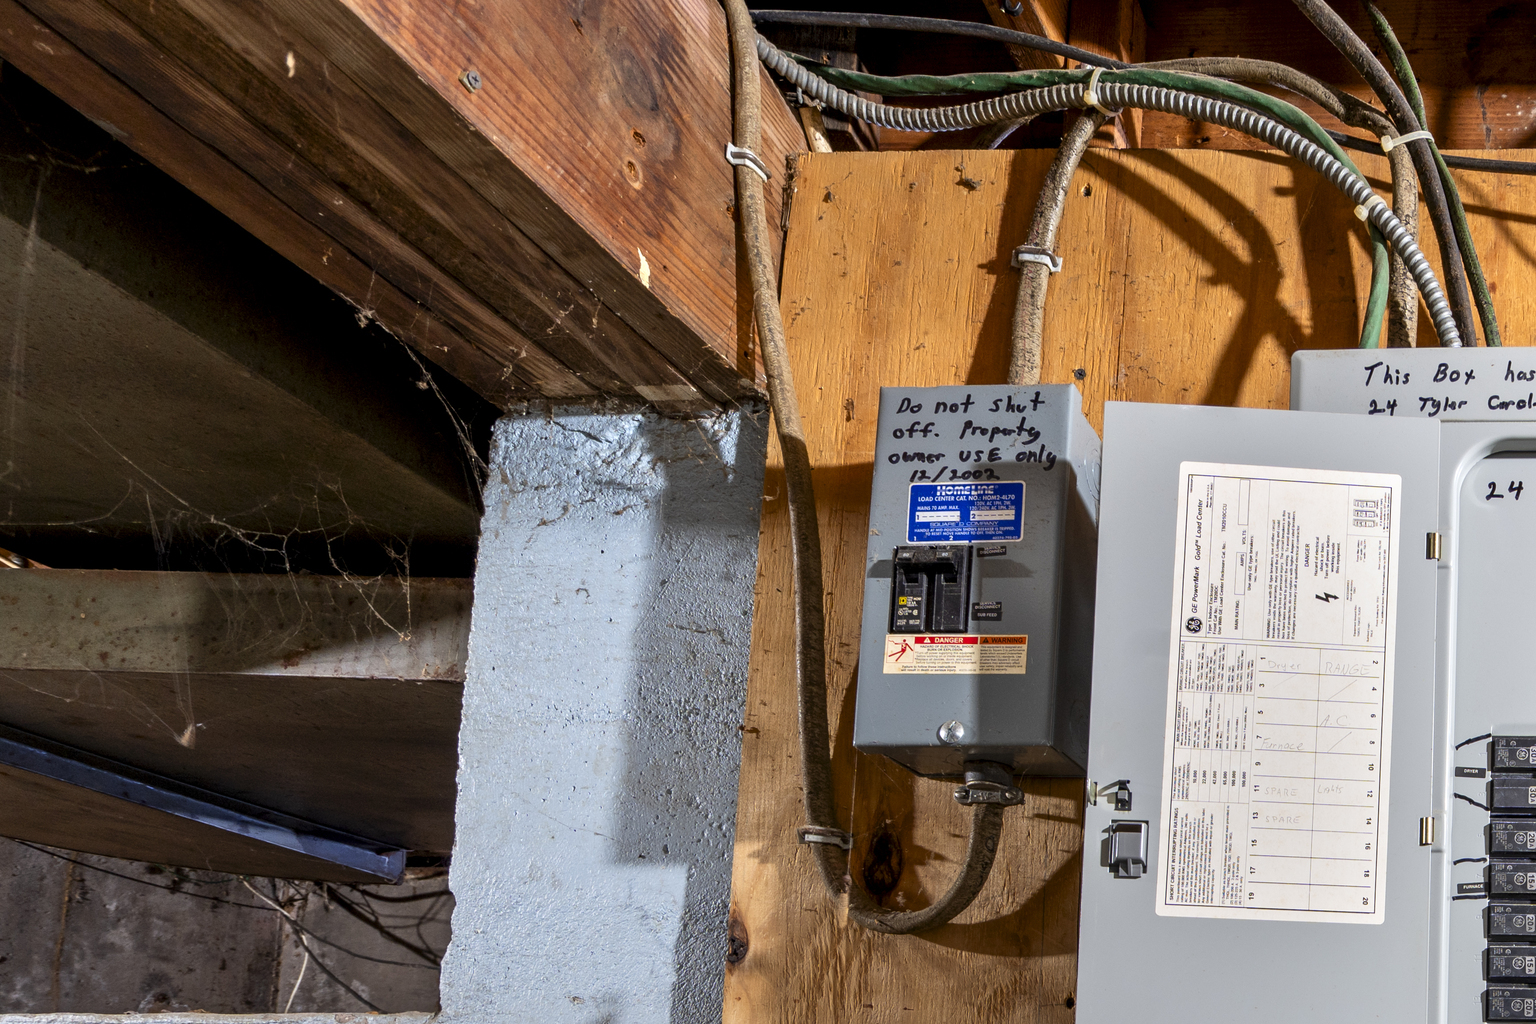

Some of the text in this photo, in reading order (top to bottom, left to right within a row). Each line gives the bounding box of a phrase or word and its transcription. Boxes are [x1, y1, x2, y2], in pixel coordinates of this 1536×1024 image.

[1365, 362, 1410, 386] This
[1433, 363, 1476, 384] Box
[1505, 361, 1536, 382] has
[896, 391, 1045, 414] Do not shut
[1368, 399, 1397, 415] 24
[1419, 396, 1468, 417] Tyler
[893, 417, 1041, 445] off. Property
[888, 452, 945, 464] owner
[1015, 444, 1057, 471] only
[910, 466, 1000, 482] 12/2002
[1486, 481, 1523, 501] 24
[1191, 603, 1197, 613] GE
[1325, 660, 1370, 676] RANGE
[1368, 763, 1374, 771] 10
[1254, 784, 1259, 792] 11
[1264, 786, 1298, 796] SPARE
[1252, 811, 1258, 819] 13
[1265, 813, 1301, 823] SPARE
[1251, 838, 1257, 846] 15
[1250, 866, 1255, 874] 17
[1363, 869, 1369, 877] 18
[1248, 891, 1254, 900] 19
[1362, 896, 1368, 905] 20
